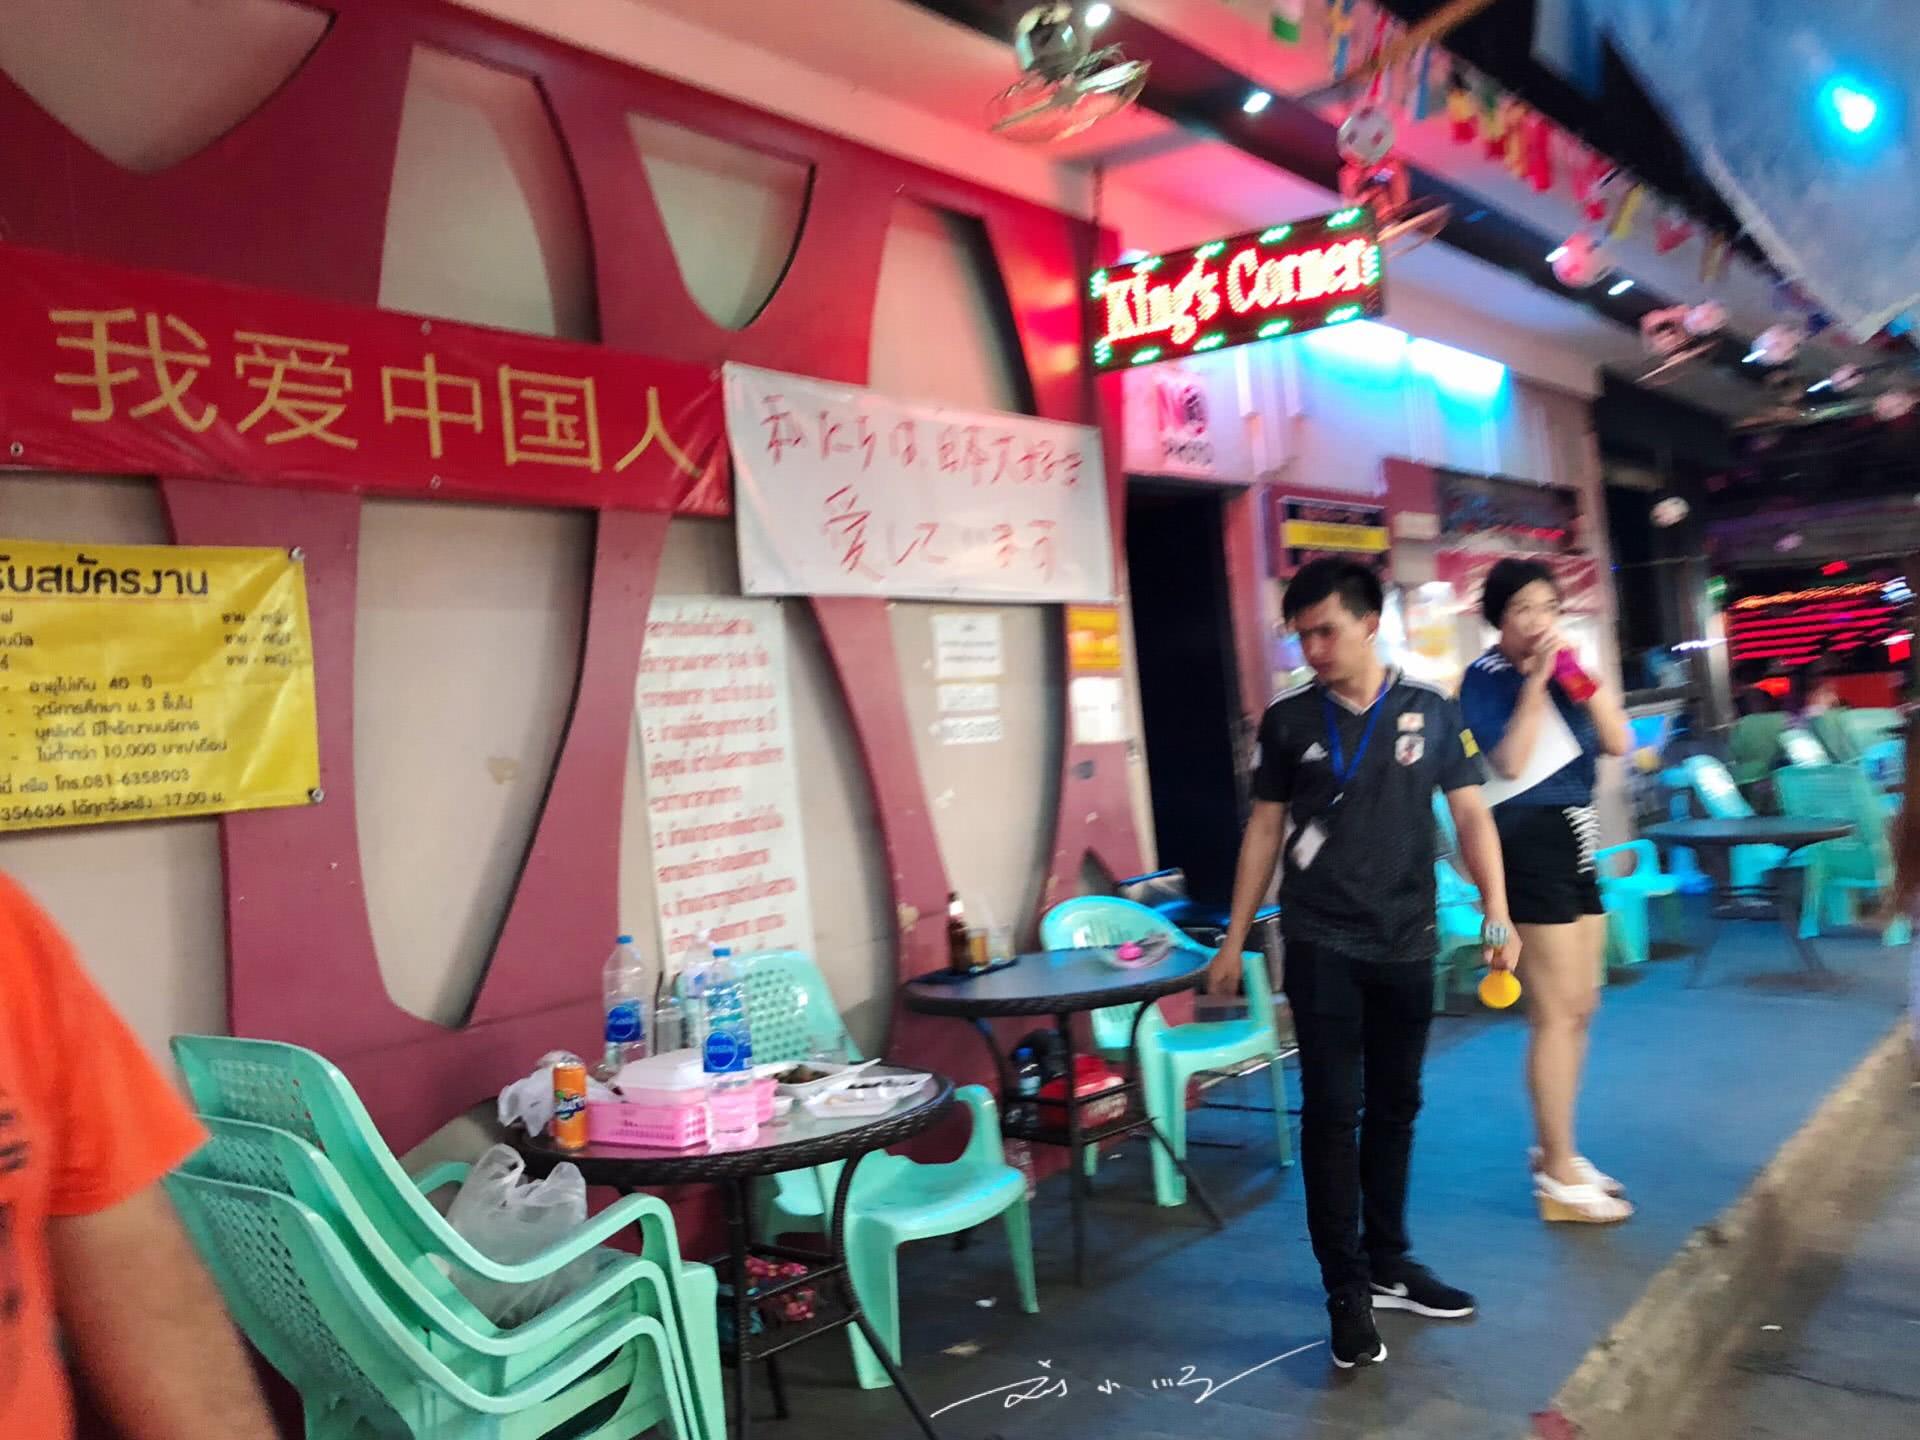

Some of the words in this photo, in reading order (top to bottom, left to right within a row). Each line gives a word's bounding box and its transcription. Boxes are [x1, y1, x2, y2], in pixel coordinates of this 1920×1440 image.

[1102, 257, 1221, 345] King's
[1226, 238, 1369, 314] Corner
[49, 308, 700, 479] 我爱中国人
[0, 554, 208, 595] ับสมัครงาน
[109, 677, 129, 690] 40
